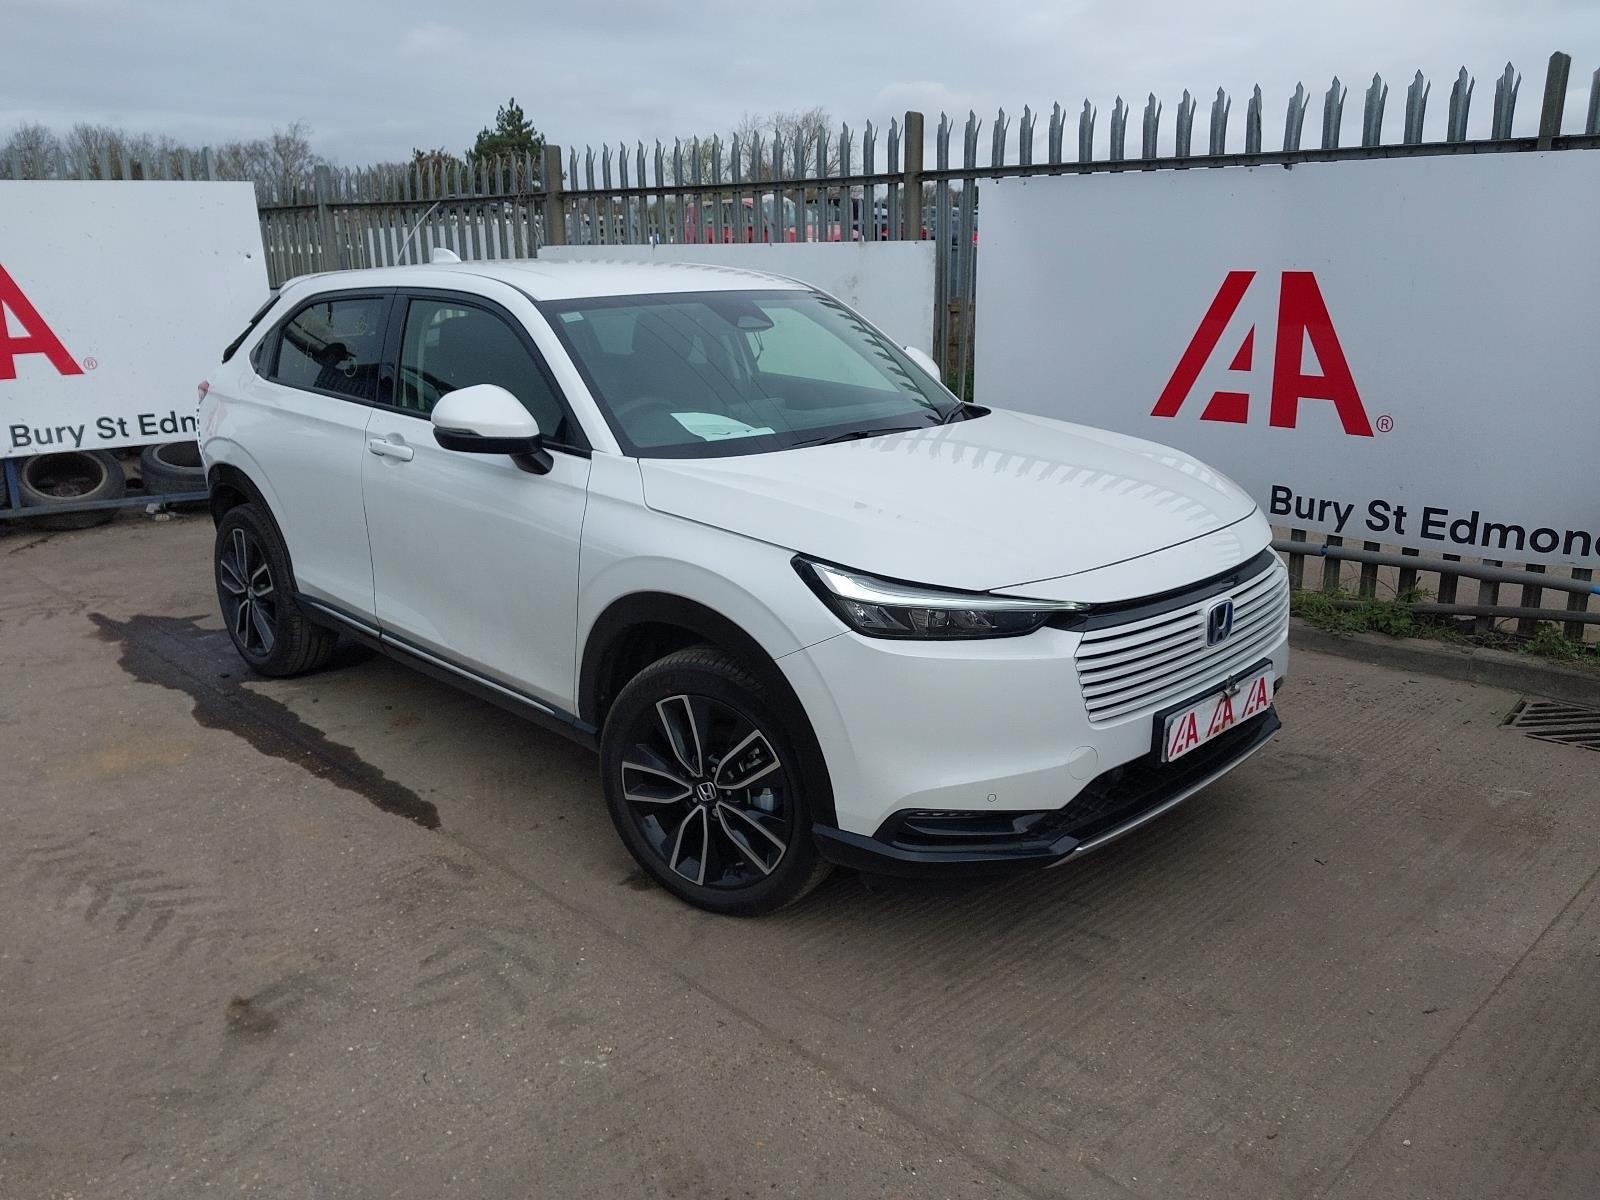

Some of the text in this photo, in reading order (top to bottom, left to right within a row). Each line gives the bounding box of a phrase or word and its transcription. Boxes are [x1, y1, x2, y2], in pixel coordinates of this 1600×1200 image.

[9, 424, 85, 448] Bury
[96, 416, 130, 439] St
[1269, 484, 1600, 558] Bury St Edmon
